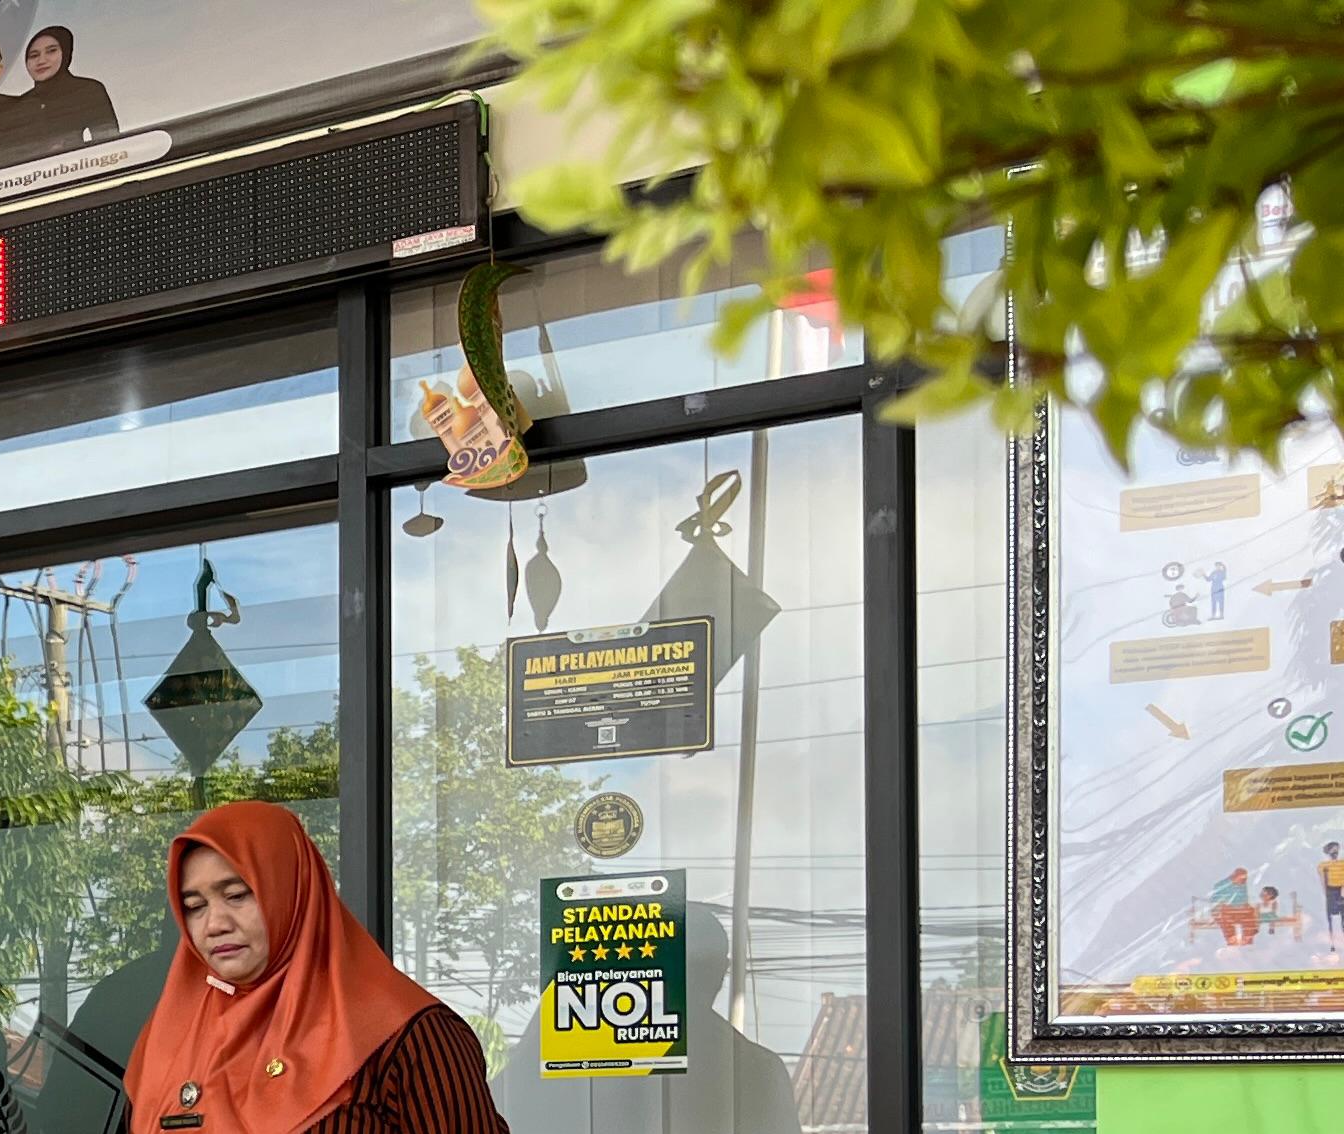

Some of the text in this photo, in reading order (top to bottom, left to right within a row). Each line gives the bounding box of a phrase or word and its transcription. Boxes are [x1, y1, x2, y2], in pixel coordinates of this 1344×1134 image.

[525, 640, 695, 676] JAM PELAYANAN PTSP
[554, 664, 690, 685] HARI JAM PELAYANAN
[1273, 701, 1286, 715] 7
[562, 902, 662, 924] STANDAR
[550, 920, 675, 944] PELAYANAN
[557, 968, 663, 983] Biaya Pelayanan
[556, 981, 679, 1029] NOL
[616, 1026, 679, 1041] RUPIAH
